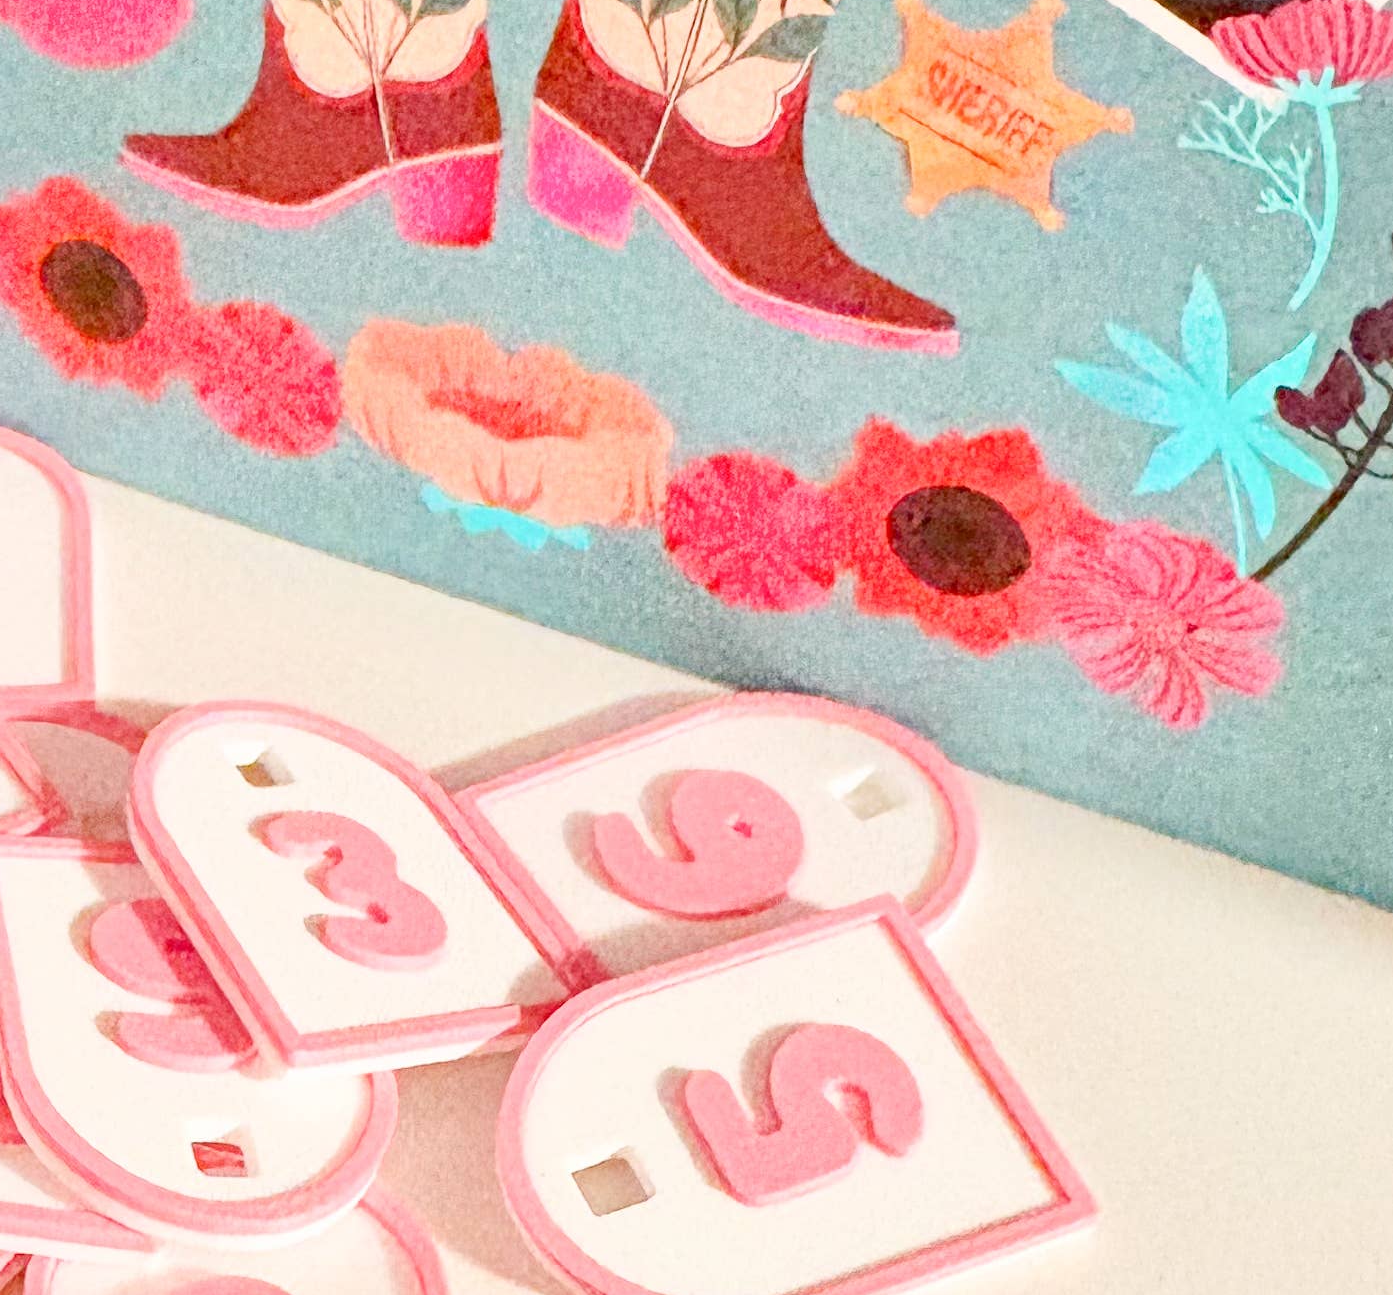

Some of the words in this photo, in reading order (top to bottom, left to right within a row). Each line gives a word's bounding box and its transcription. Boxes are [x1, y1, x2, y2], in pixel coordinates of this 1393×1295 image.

[928, 59, 1056, 156] SHERIFF
[248, 810, 448, 972] 3
[682, 1021, 925, 1207] 5
